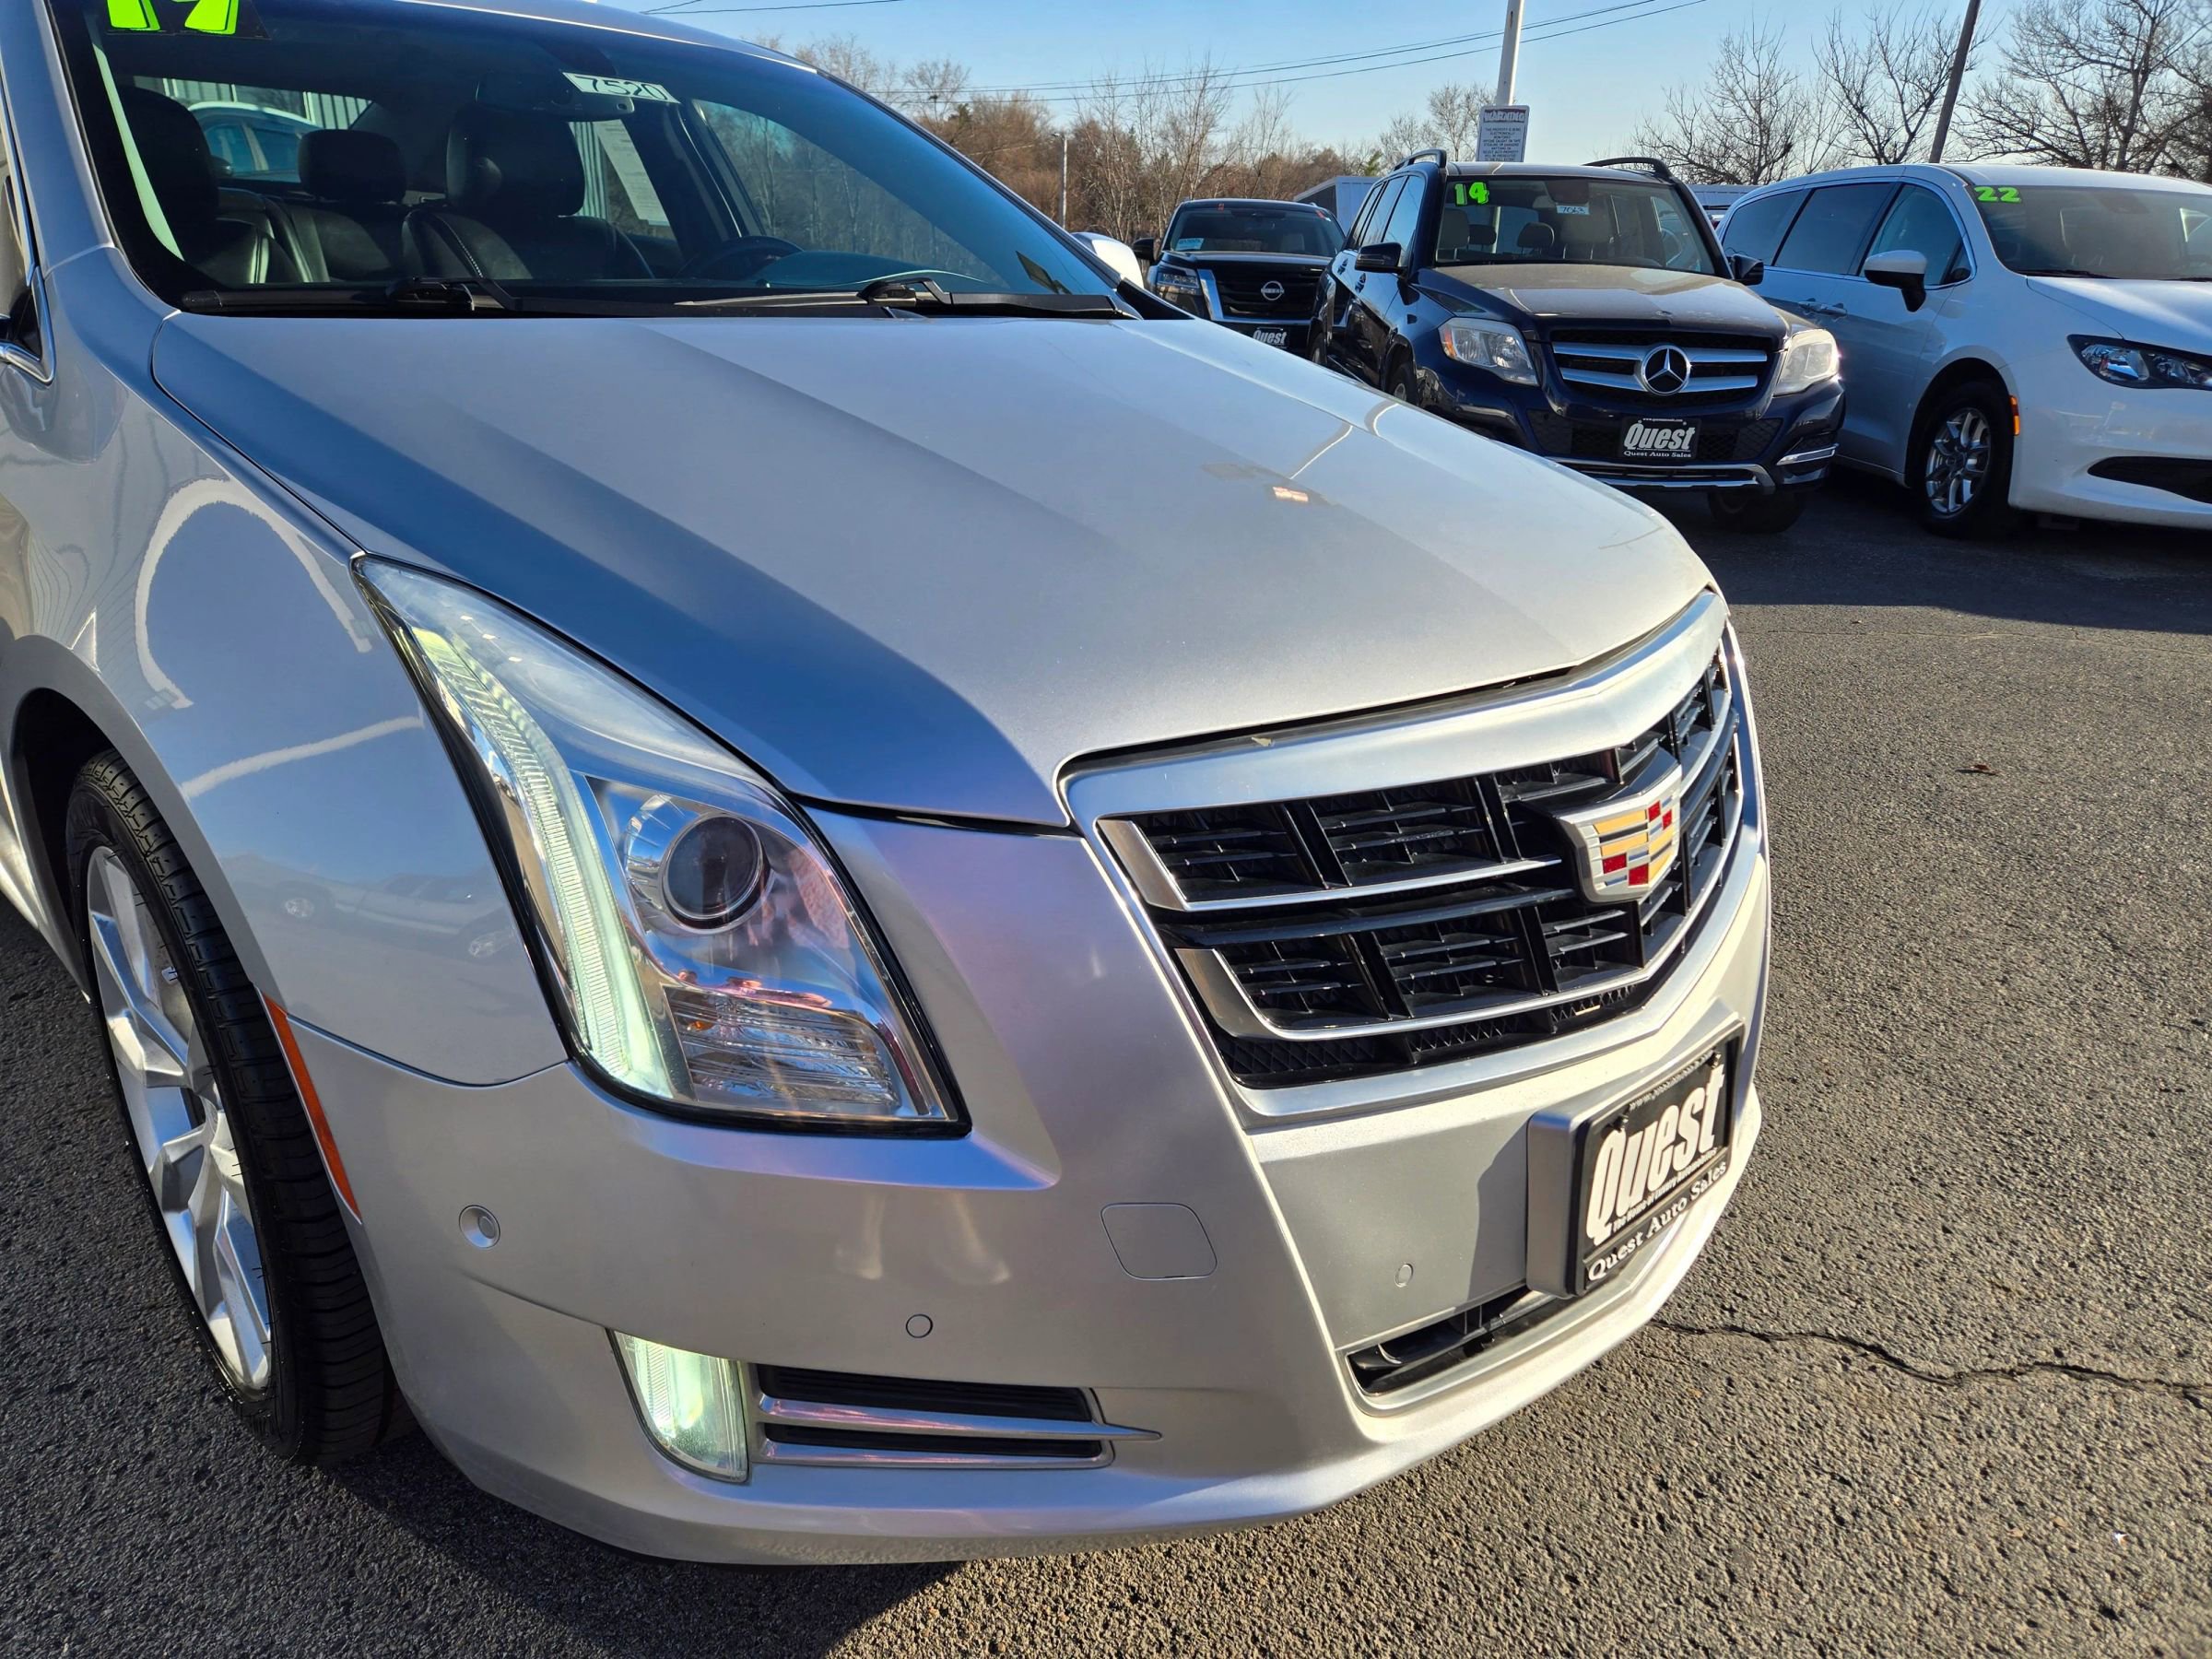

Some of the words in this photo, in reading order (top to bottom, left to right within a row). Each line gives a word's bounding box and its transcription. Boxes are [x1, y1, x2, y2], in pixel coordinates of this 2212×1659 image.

[574, 76, 668, 100] 7520
[1484, 110, 1525, 121] WARNING
[1454, 181, 1490, 206] 14
[1974, 186, 2021, 204] 22
[1253, 330, 1287, 346] Quest
[1624, 423, 1695, 450] Quest
[1586, 1064, 1724, 1246] Quest
[1588, 1231, 1643, 1280] Quest
[1646, 1197, 1687, 1239] Auto
[1690, 1161, 1726, 1201] Sales
